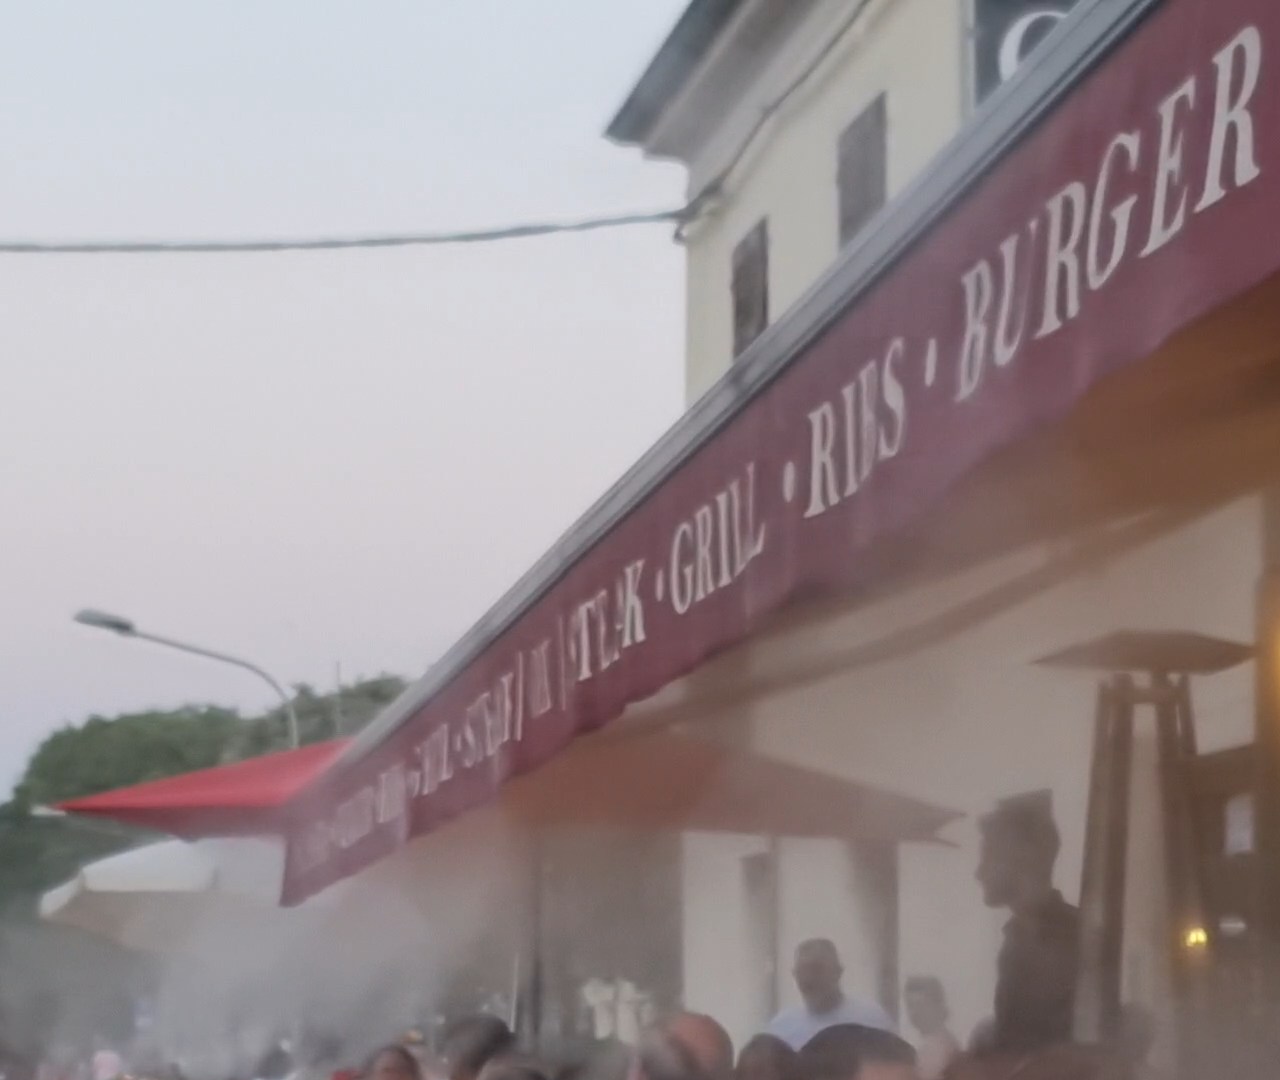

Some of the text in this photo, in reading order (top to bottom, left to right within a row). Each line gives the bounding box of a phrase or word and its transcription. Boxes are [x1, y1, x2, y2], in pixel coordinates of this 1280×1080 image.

[568, 558, 647, 682] TEK
[670, 462, 766, 614] GRILL
[954, 26, 1261, 402] BURGER
